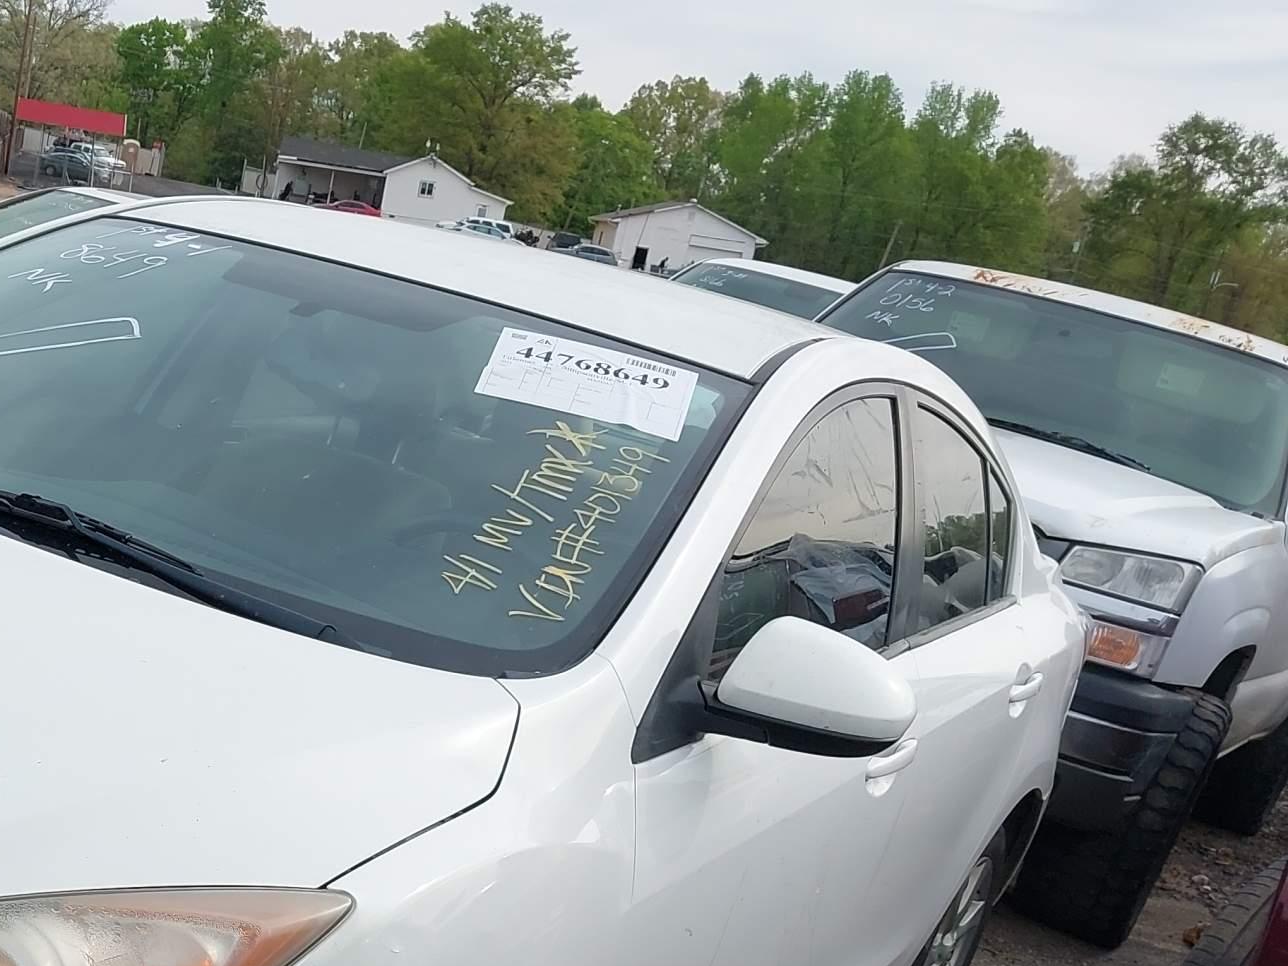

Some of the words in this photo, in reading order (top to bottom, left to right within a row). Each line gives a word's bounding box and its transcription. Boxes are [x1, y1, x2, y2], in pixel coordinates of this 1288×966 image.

[59, 242, 169, 280] 8649
[7, 267, 73, 294] NK
[879, 292, 936, 313] 0156
[864, 309, 901, 328] NK
[515, 345, 671, 390] 44768649
